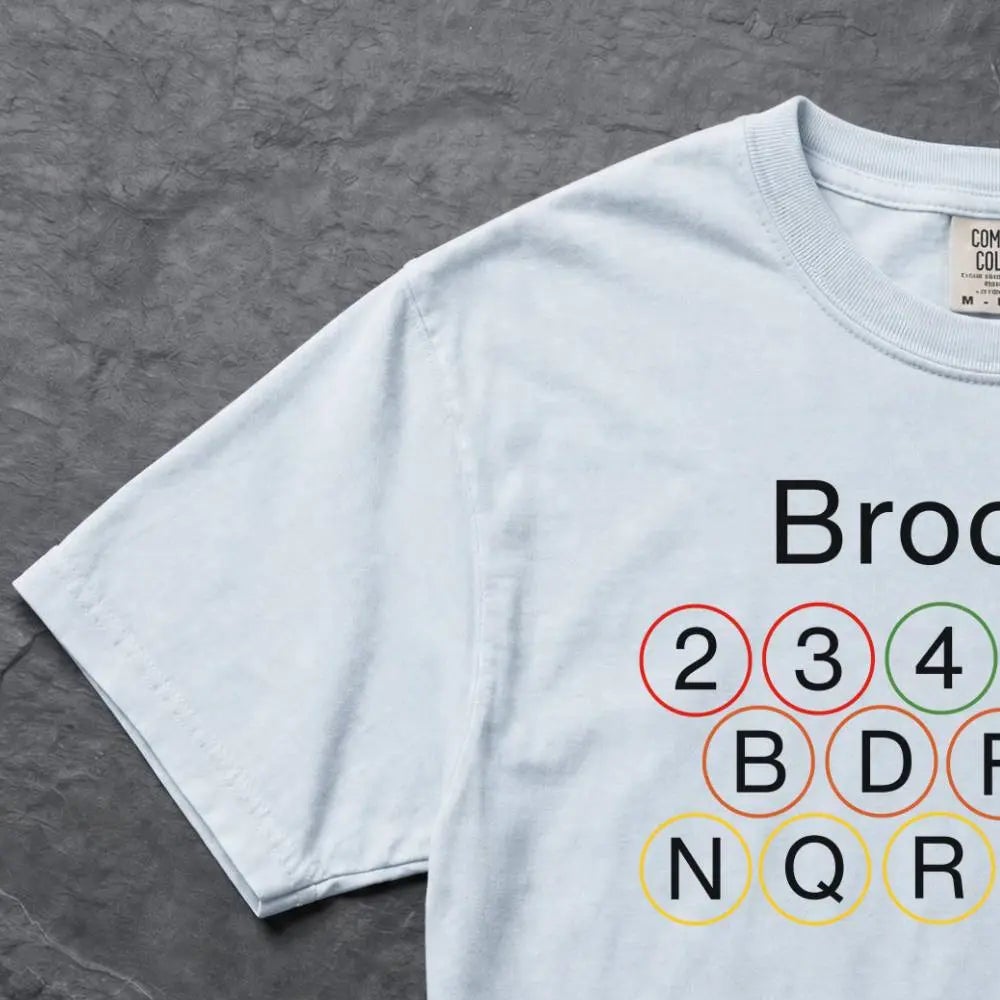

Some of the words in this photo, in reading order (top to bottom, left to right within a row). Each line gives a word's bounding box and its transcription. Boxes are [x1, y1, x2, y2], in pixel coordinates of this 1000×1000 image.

[962, 296, 974, 305] M
[675, 627, 717, 690] 2
[795, 627, 842, 691] 3
[915, 626, 963, 689] 4
[736, 730, 786, 793] B
[861, 730, 912, 793] D
[671, 837, 721, 900] N
[784, 835, 844, 903] Q
[915, 836, 964, 899] R
